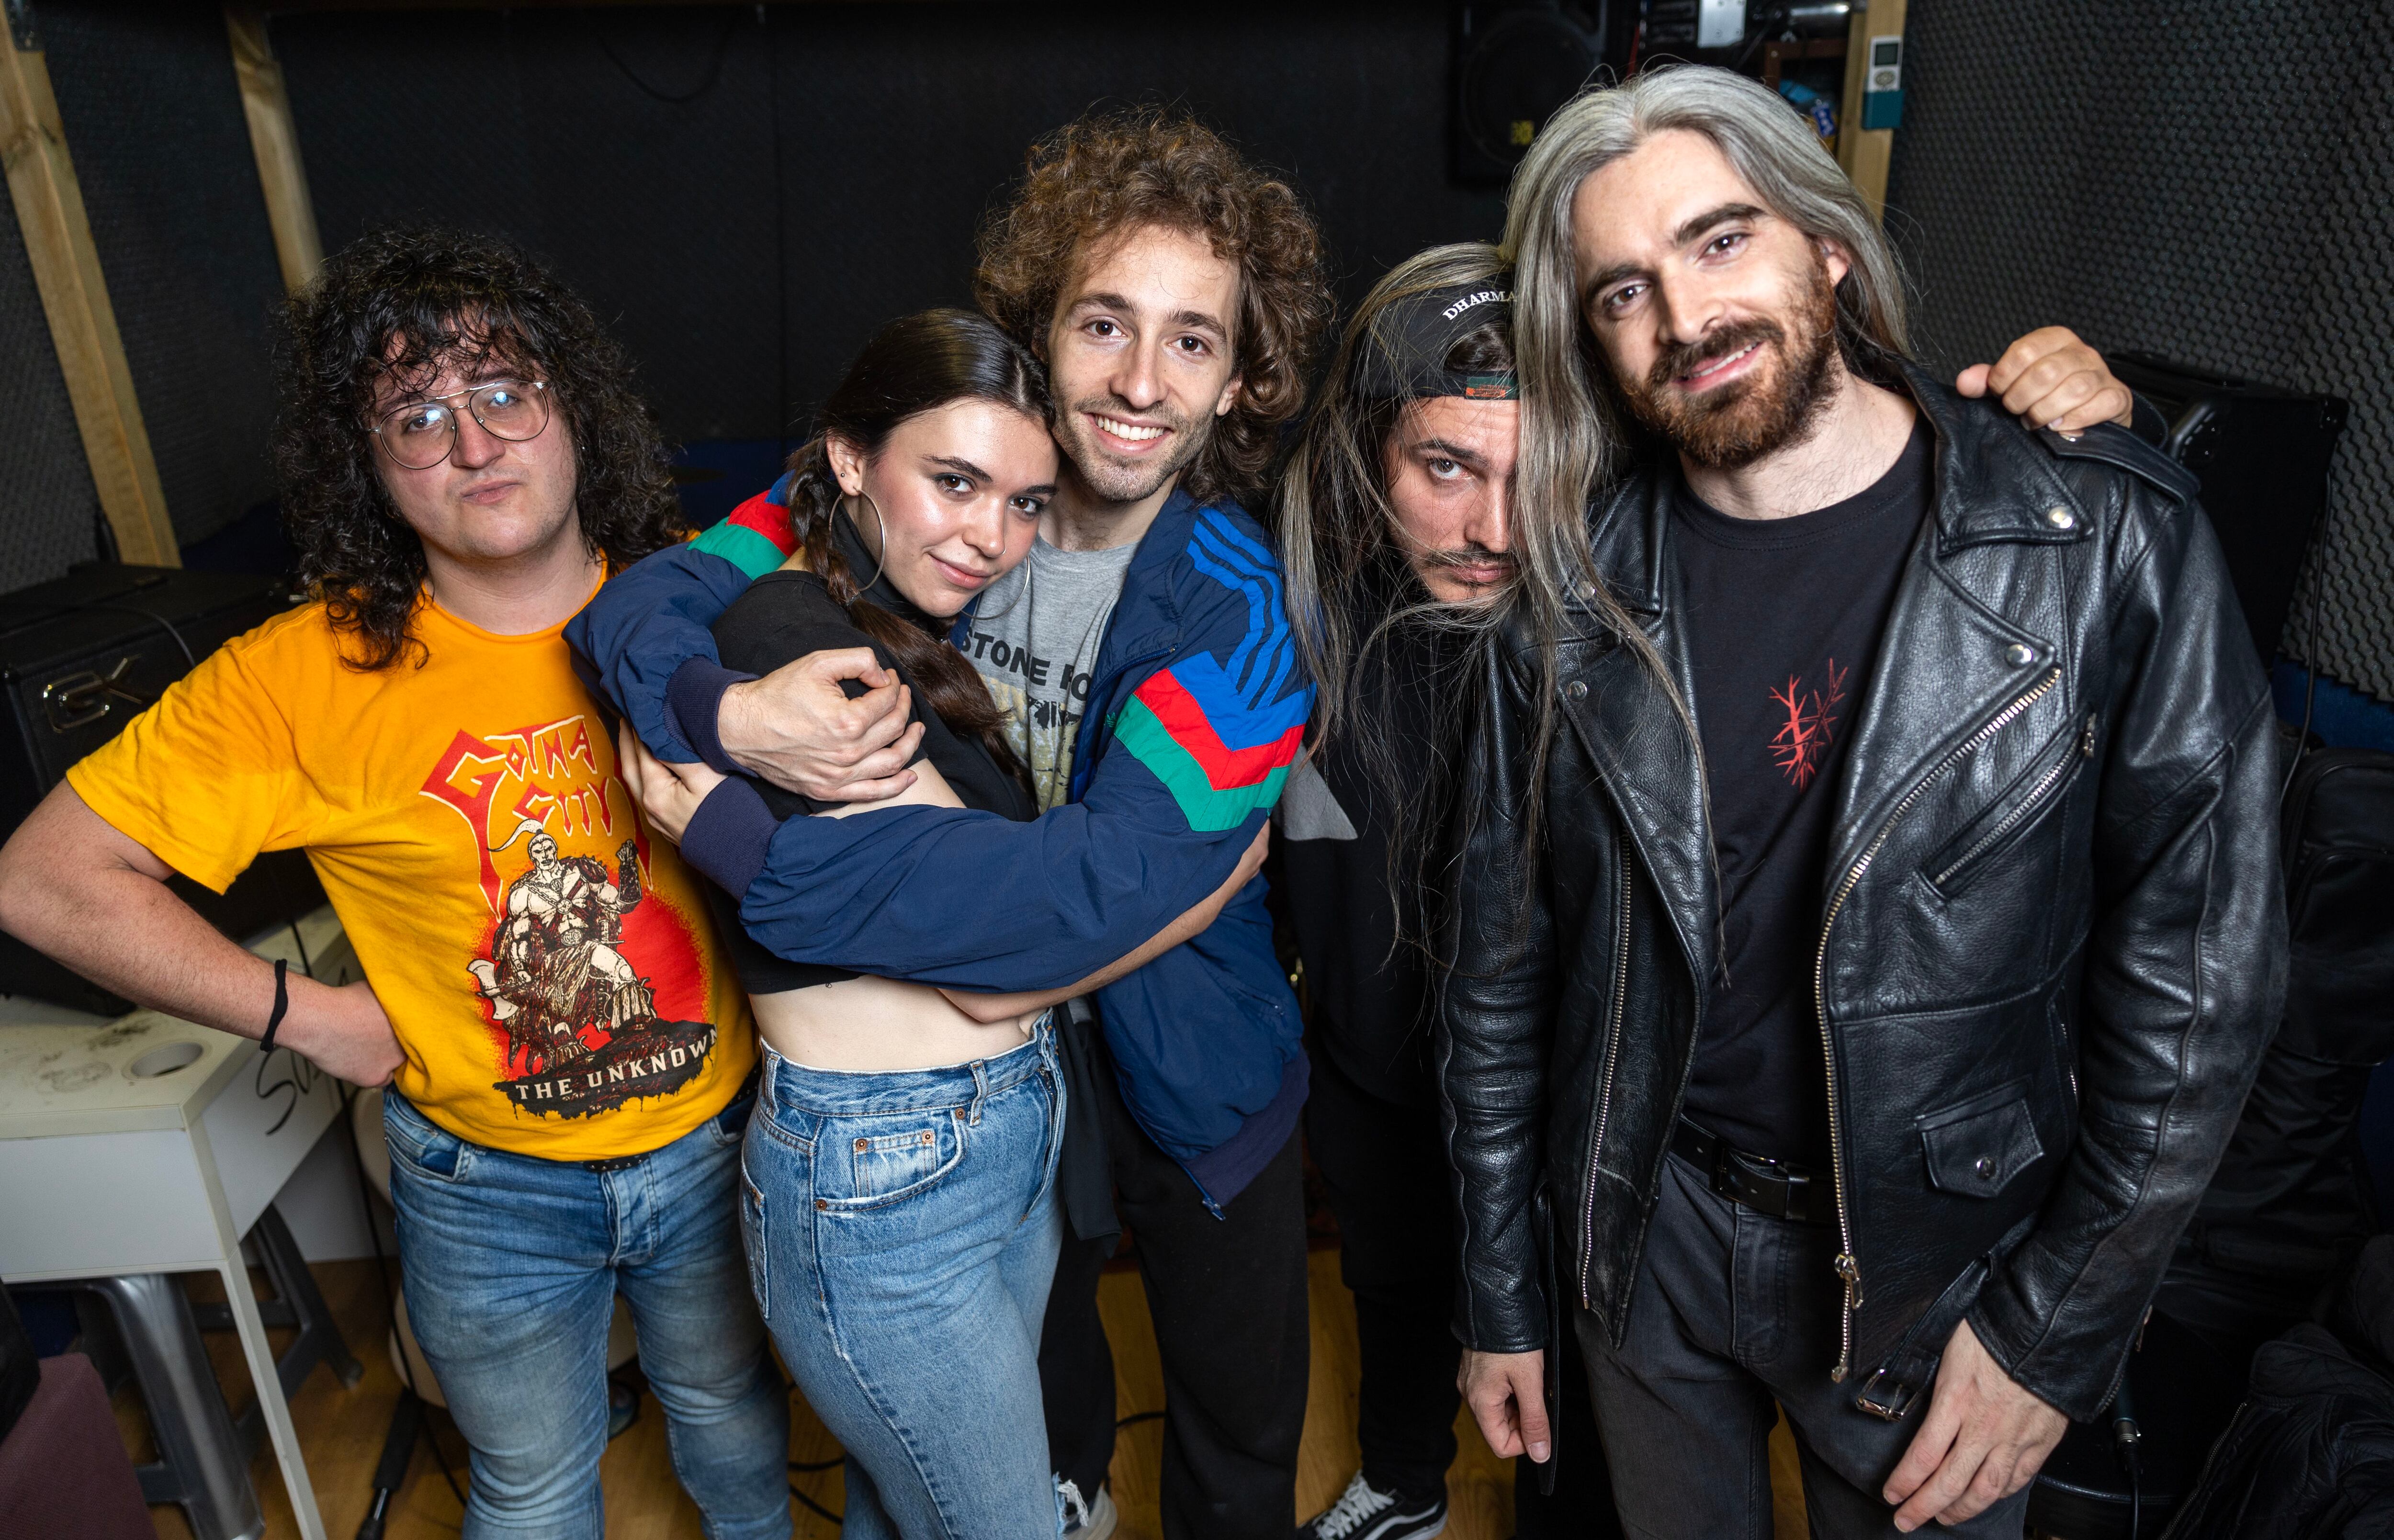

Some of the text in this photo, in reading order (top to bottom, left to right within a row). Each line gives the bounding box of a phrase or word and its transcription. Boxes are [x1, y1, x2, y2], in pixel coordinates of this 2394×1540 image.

[1442, 291, 1517, 320] DHARMA
[962, 626, 1050, 686] STONE
[512, 776, 613, 837] CITY
[515, 1023, 718, 1100] THE UNKNOWN
